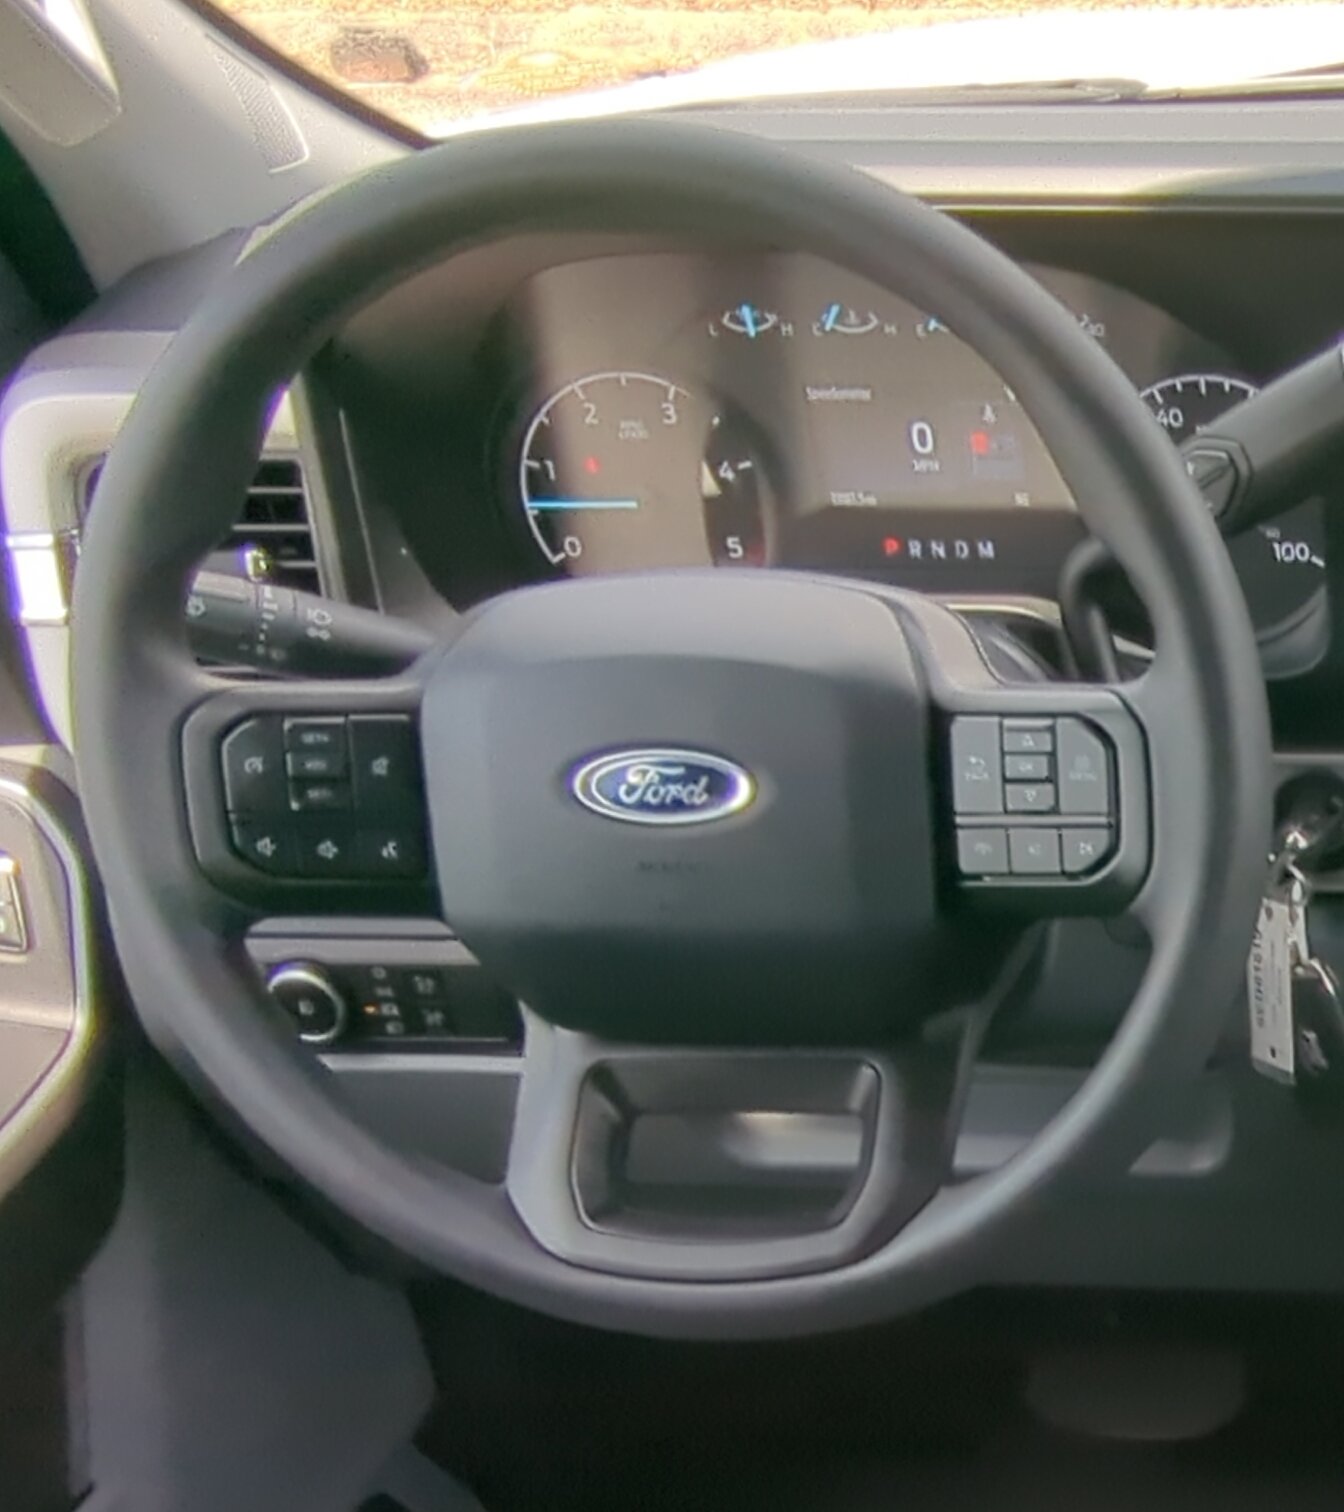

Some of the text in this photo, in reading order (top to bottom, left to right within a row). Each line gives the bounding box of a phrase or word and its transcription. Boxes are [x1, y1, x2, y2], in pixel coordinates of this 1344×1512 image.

[781, 324, 794, 336] H
[584, 403, 598, 424] 2
[661, 403, 677, 424] 3
[1155, 408, 1183, 428] 40
[912, 421, 934, 454] 0
[544, 460, 555, 481] 1
[719, 461, 735, 482] 4
[564, 536, 582, 557] 0
[727, 537, 743, 558] 5
[885, 537, 995, 559] P R N D M
[1273, 542, 1310, 562] 100
[618, 764, 709, 805] Ford
